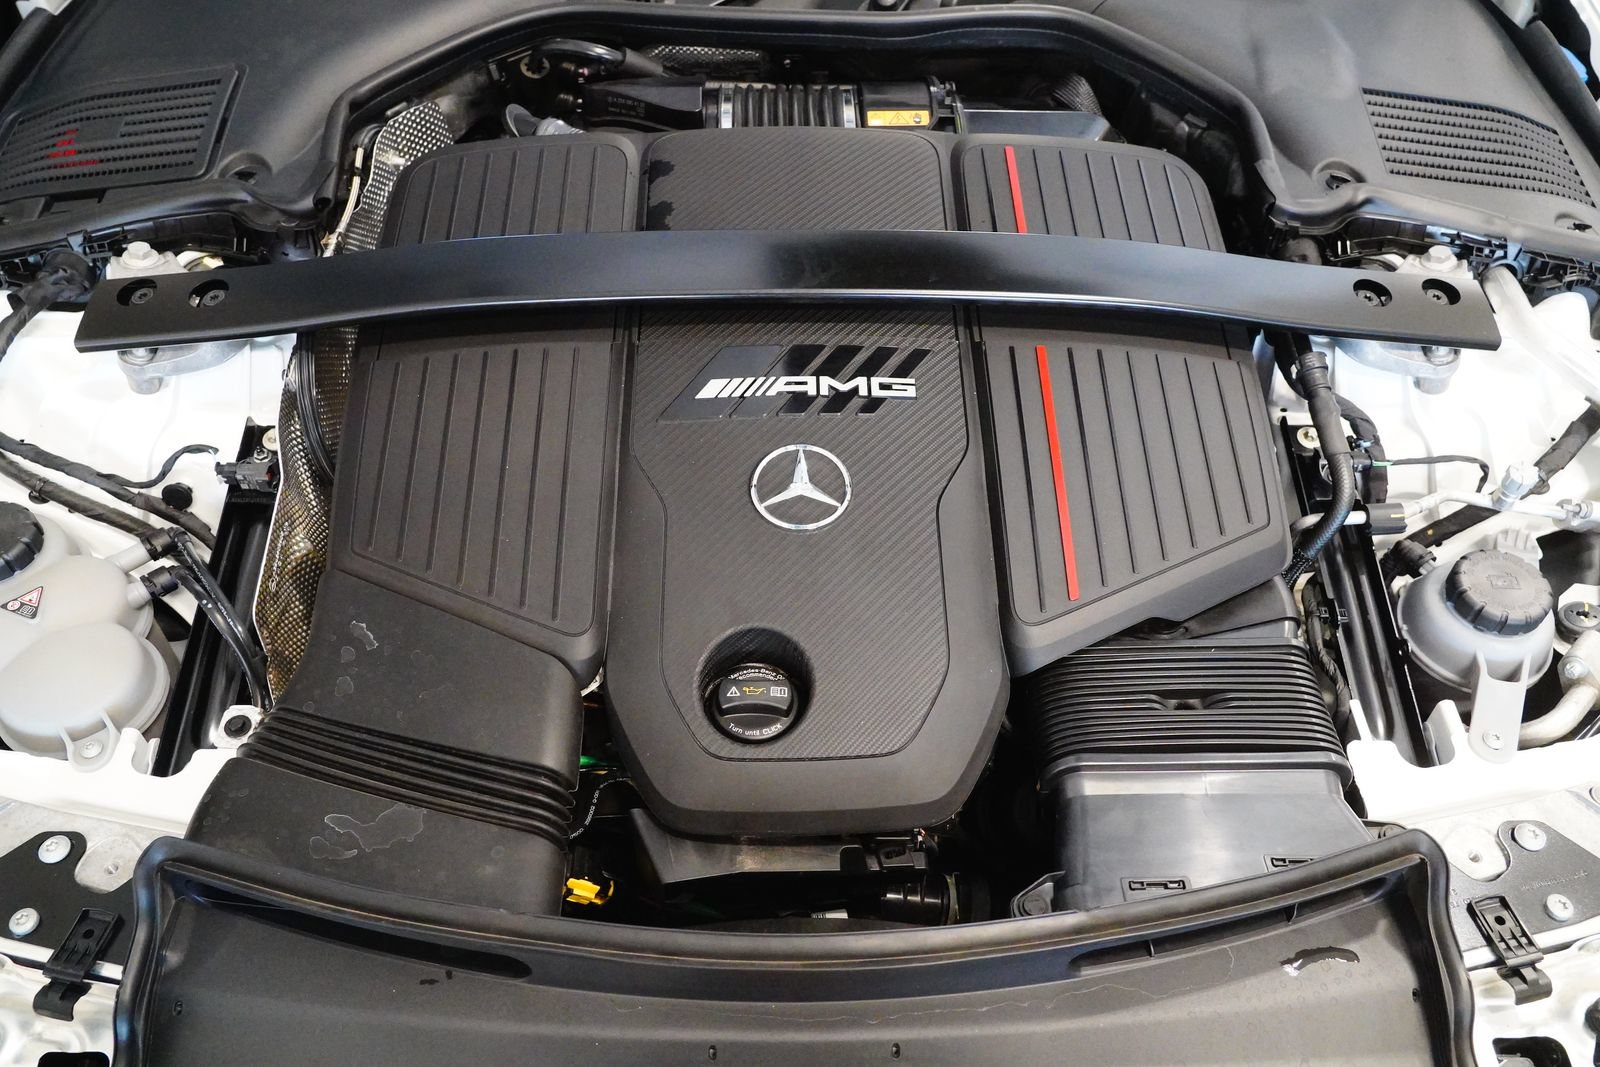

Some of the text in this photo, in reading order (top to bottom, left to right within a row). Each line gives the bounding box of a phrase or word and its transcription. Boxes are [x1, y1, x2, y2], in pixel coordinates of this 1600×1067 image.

[765, 375, 918, 399] AMG
[729, 722, 743, 734] Turn
[762, 722, 783, 735] CLICK
